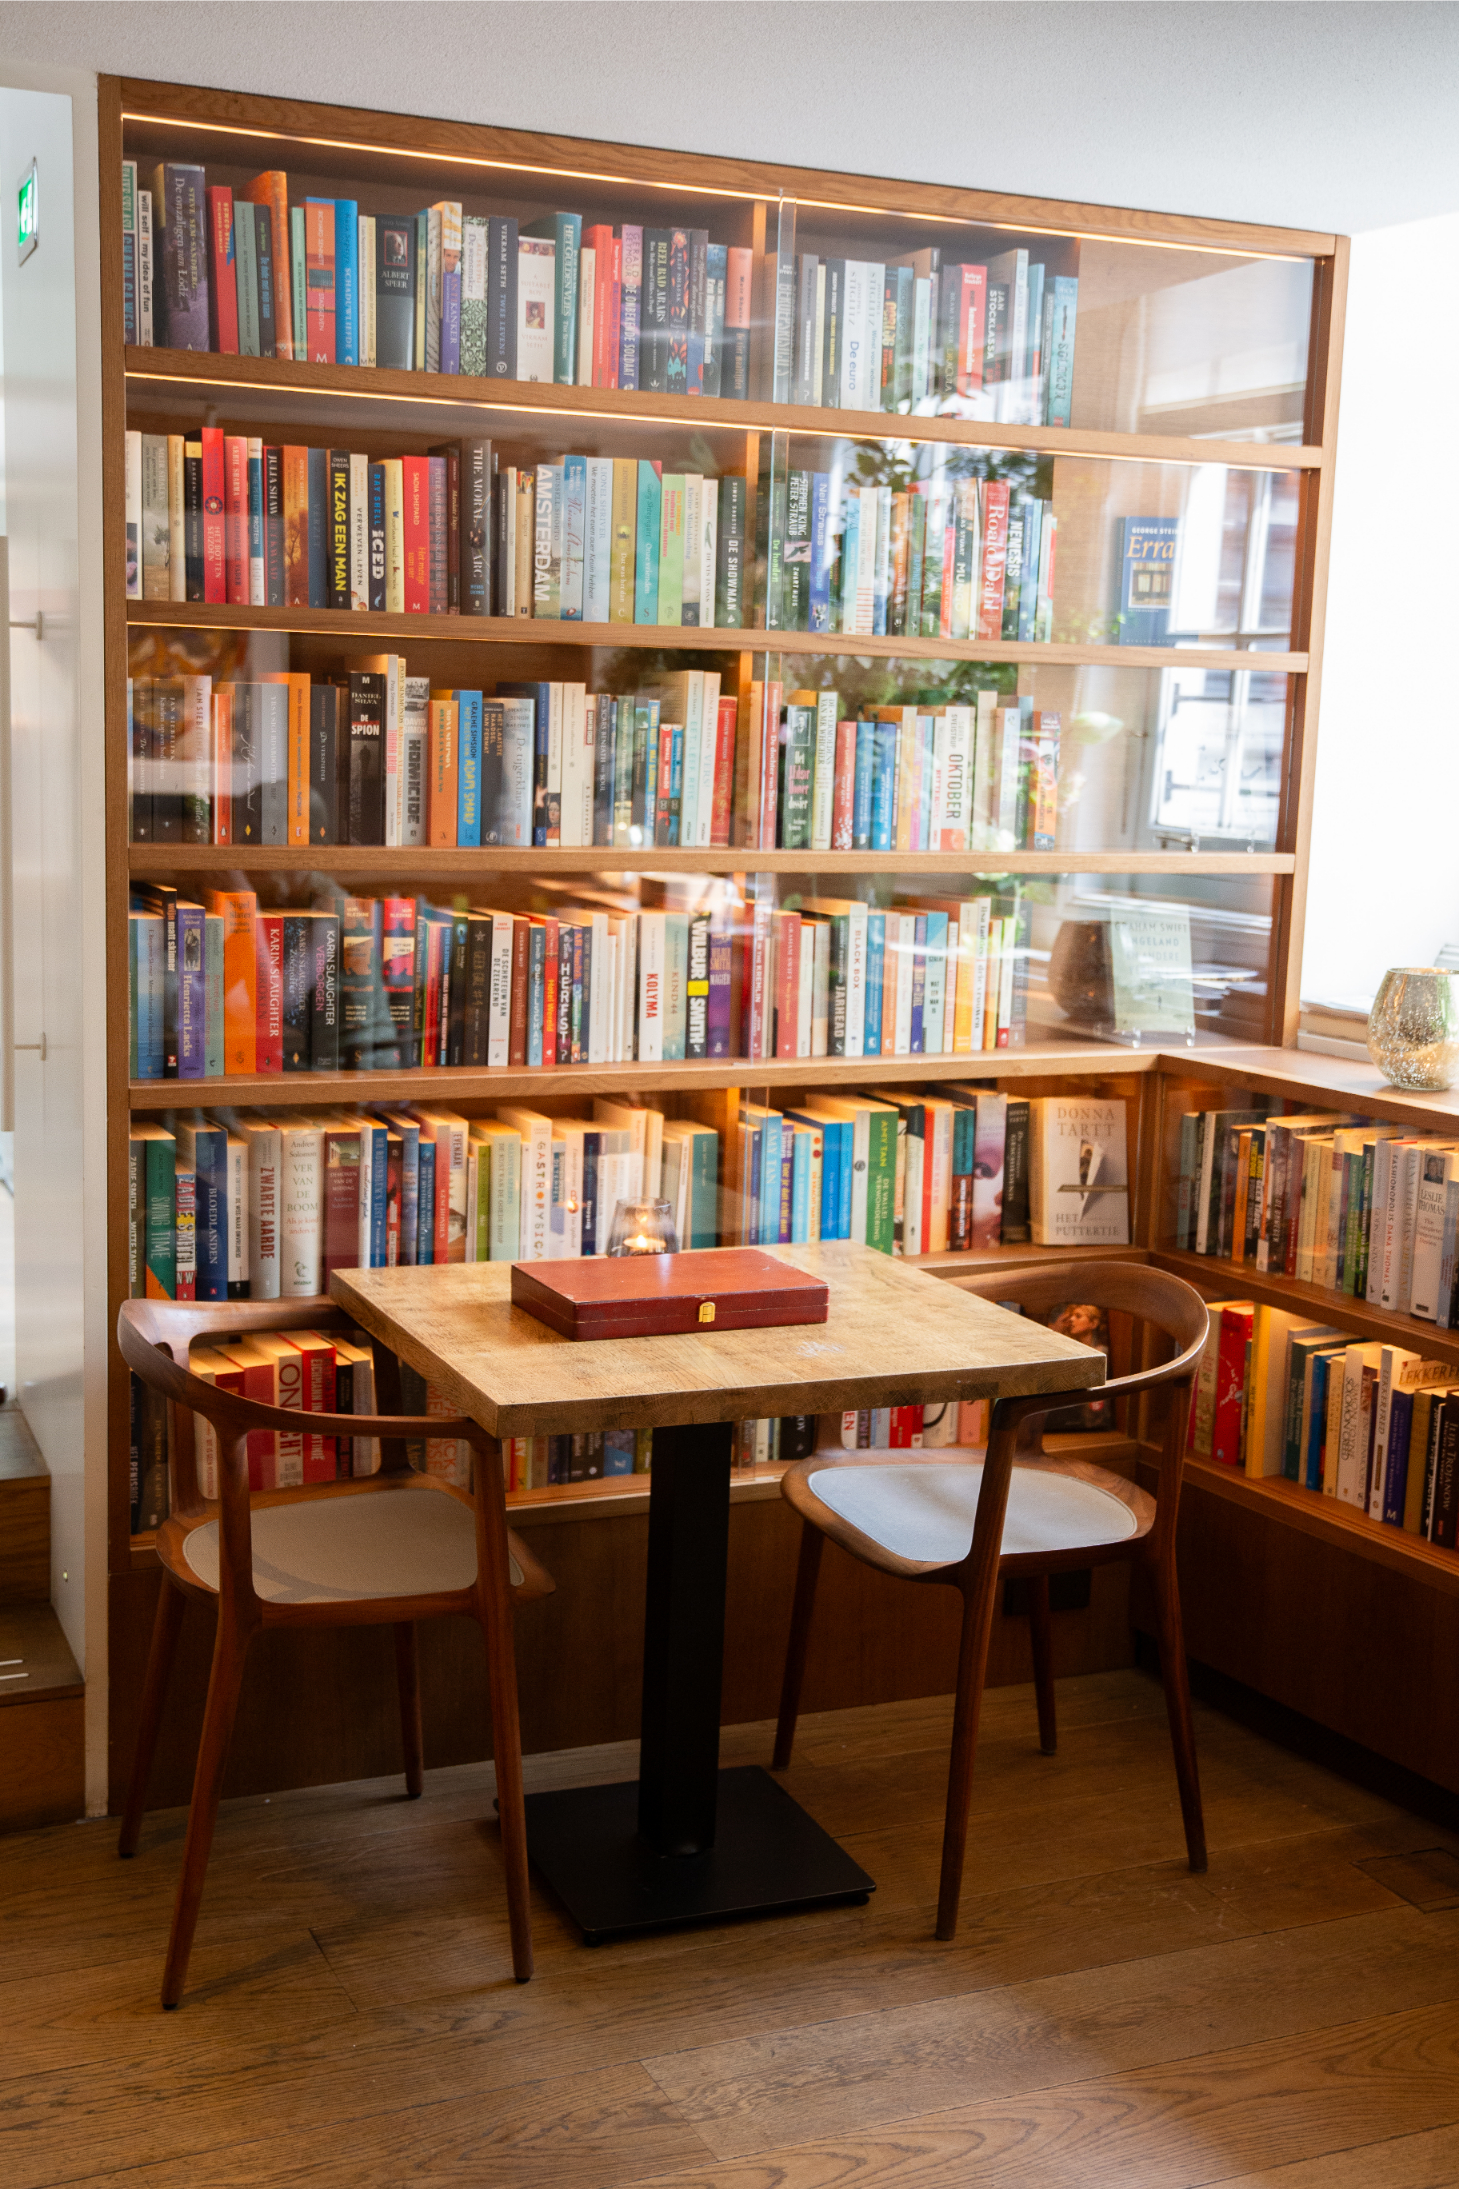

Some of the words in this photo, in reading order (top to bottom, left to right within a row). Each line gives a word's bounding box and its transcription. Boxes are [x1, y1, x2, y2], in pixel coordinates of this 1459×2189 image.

[175, 178, 185, 193] De
[141, 195, 149, 213] will
[141, 216, 149, 234] self
[173, 195, 185, 247] onzaligen
[140, 244, 149, 259] my
[468, 234, 476, 247] De
[500, 225, 508, 262] VIKRAM
[625, 232, 633, 278] SEYMOUR
[658, 242, 667, 266] REEL
[142, 261, 150, 282] idea
[177, 250, 186, 266] van
[467, 249, 475, 293] wensmaker
[178, 270, 188, 297] Łódź
[382, 271, 409, 279] ALBERT
[384, 280, 408, 289] SPEER
[625, 283, 636, 295] DE
[657, 267, 667, 288] BAD
[706, 279, 716, 293] Een
[142, 285, 150, 295] of
[997, 290, 1005, 311] JAN
[344, 268, 352, 349] SCHADUWLIEFDE
[624, 296, 636, 342] ONBEKENDE
[656, 289, 666, 322] ARABS
[705, 295, 715, 335] Russische
[498, 321, 506, 355] LEVENS
[987, 290, 998, 360] STOCKLASSA
[704, 337, 712, 363] roman
[850, 341, 859, 358] De
[966, 307, 977, 373] keukenmeiden
[623, 344, 635, 376] SOLDAAT
[849, 361, 857, 390] euro
[267, 455, 278, 484] JULIA
[473, 447, 483, 475] THE
[335, 473, 346, 487] IK
[789, 477, 799, 500] PETER
[798, 478, 808, 511] STEPHEN
[818, 484, 827, 504] Neil
[269, 485, 278, 515] SHAW
[335, 491, 346, 522] ZAG
[473, 478, 483, 522] MORAL
[534, 466, 552, 601] AMSTERDAM
[788, 503, 798, 536] STRAUB
[797, 515, 807, 536] KING
[817, 506, 826, 546] Strauss
[986, 505, 1005, 559] Roald
[1132, 526, 1158, 535] GEORGE
[335, 525, 346, 554] EEN
[644, 543, 652, 560] Onze
[728, 540, 738, 553] DE
[772, 539, 781, 550] De
[1007, 521, 1023, 577] NEMESIS
[417, 547, 426, 563] Het
[473, 552, 483, 577] ARC
[771, 552, 781, 583] honden
[335, 557, 347, 591] MAN
[415, 564, 426, 585] meisje
[727, 557, 738, 611] SHOWMAN
[955, 562, 966, 612] MUNGO
[983, 565, 1001, 611] Dahl
[360, 714, 369, 722] DE
[470, 701, 478, 728] GRAEME
[351, 725, 380, 735] SPION
[470, 730, 478, 758] SIMSION
[515, 738, 526, 751] De
[770, 735, 777, 746] De
[463, 759, 474, 789] ADAM
[769, 748, 777, 775] dochter
[407, 739, 421, 825] HOMICIDE
[513, 754, 525, 810] tijgerklauw
[946, 754, 963, 819] OKTOBER
[463, 793, 474, 825] SHARP
[166, 903, 176, 921] wijn
[168, 922, 176, 941] matt
[167, 943, 177, 972] skinner
[270, 928, 280, 965] KARIN
[326, 930, 335, 963] KARIN
[502, 948, 509, 958] DE
[691, 920, 707, 980] WILBUR
[854, 930, 862, 964] BLACK
[493, 958, 501, 967] DE
[316, 945, 324, 1011] VERBORGEN
[492, 968, 501, 1007] ZEEAREND
[501, 960, 509, 1000] SCHREEUW
[547, 979, 555, 1001] Hotel
[671, 971, 679, 1002] KIND
[183, 975, 193, 1024] Henrietta
[269, 968, 279, 1037] SLAUGHTER
[325, 965, 335, 1025] SLAUGHTER
[559, 963, 570, 1044] HERFST
[646, 973, 658, 1018] KOLYMA
[670, 1003, 679, 1014] 44
[546, 1003, 555, 1032] Wereld
[690, 997, 706, 1044] SMITH
[834, 986, 845, 1038] JARHEAD
[183, 1026, 193, 1057] Lacks
[1058, 1107, 1115, 1120] DONNA
[766, 1128, 777, 1155] AMY
[880, 1120, 888, 1142] AMY
[1057, 1123, 1115, 1137] TARTT
[452, 1133, 463, 1167] EVENAAR
[879, 1145, 887, 1167] TAN
[294, 1164, 313, 1172] VER
[766, 1160, 776, 1184] TAN
[260, 1167, 274, 1217] ZWARTE
[882, 1178, 890, 1188] DE
[1387, 1155, 1398, 1222] FASHIONOPOLIS
[1419, 1189, 1442, 1203] LESLIE
[150, 1197, 171, 1226] SWING
[178, 1178, 195, 1218] ZADIE
[287, 1204, 319, 1212] BOOM
[873, 1175, 882, 1241] VERWONDERING
[881, 1191, 889, 1219] VALLEI
[208, 1188, 218, 1264] BLOEDLANDEN
[1056, 1214, 1078, 1223] HET
[150, 1231, 171, 1259] TIME
[178, 1224, 195, 1263] SMITH
[260, 1220, 275, 1260] AARDE
[1383, 1250, 1392, 1284] THOMAS
[1343, 1377, 1354, 1429] SOLOMON
[1340, 1430, 1352, 1461] CREED
[1447, 1423, 1458, 1447] ILIJA
[1442, 1452, 1457, 1510] TROJANOW
